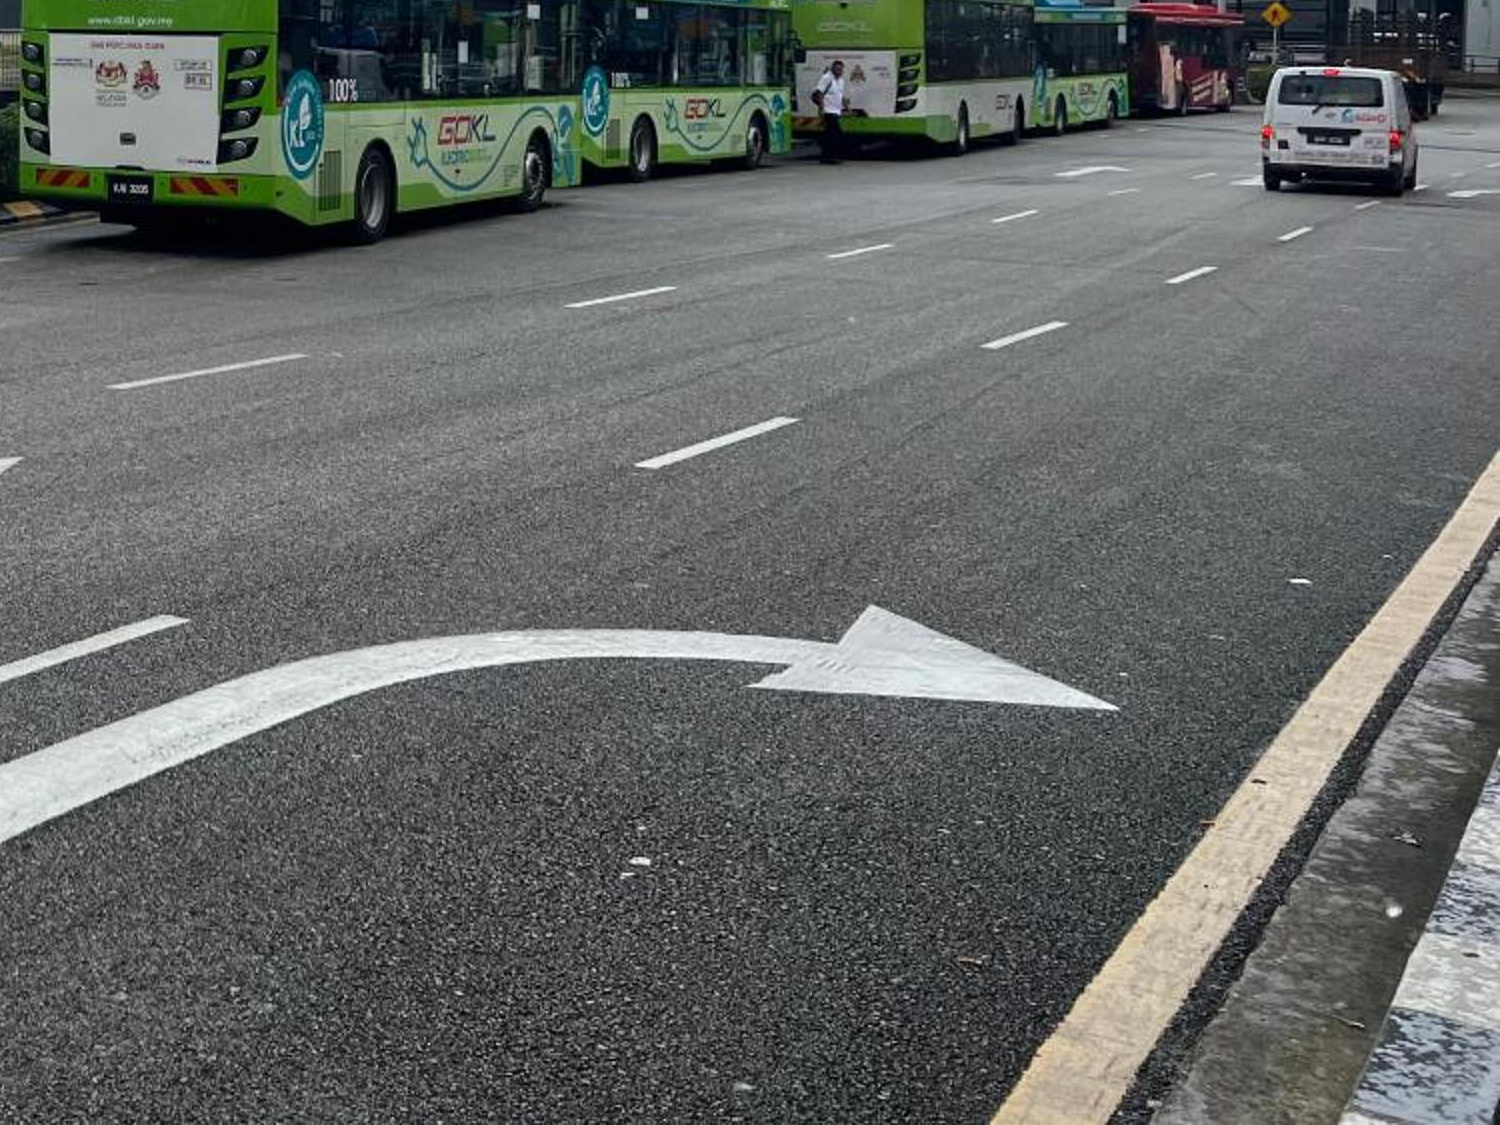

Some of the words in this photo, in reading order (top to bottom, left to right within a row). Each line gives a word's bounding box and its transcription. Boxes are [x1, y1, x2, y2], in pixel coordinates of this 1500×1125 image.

[328, 78, 358, 102] 100%
[684, 98, 726, 120] GOKL
[437, 114, 496, 145] GOKL
